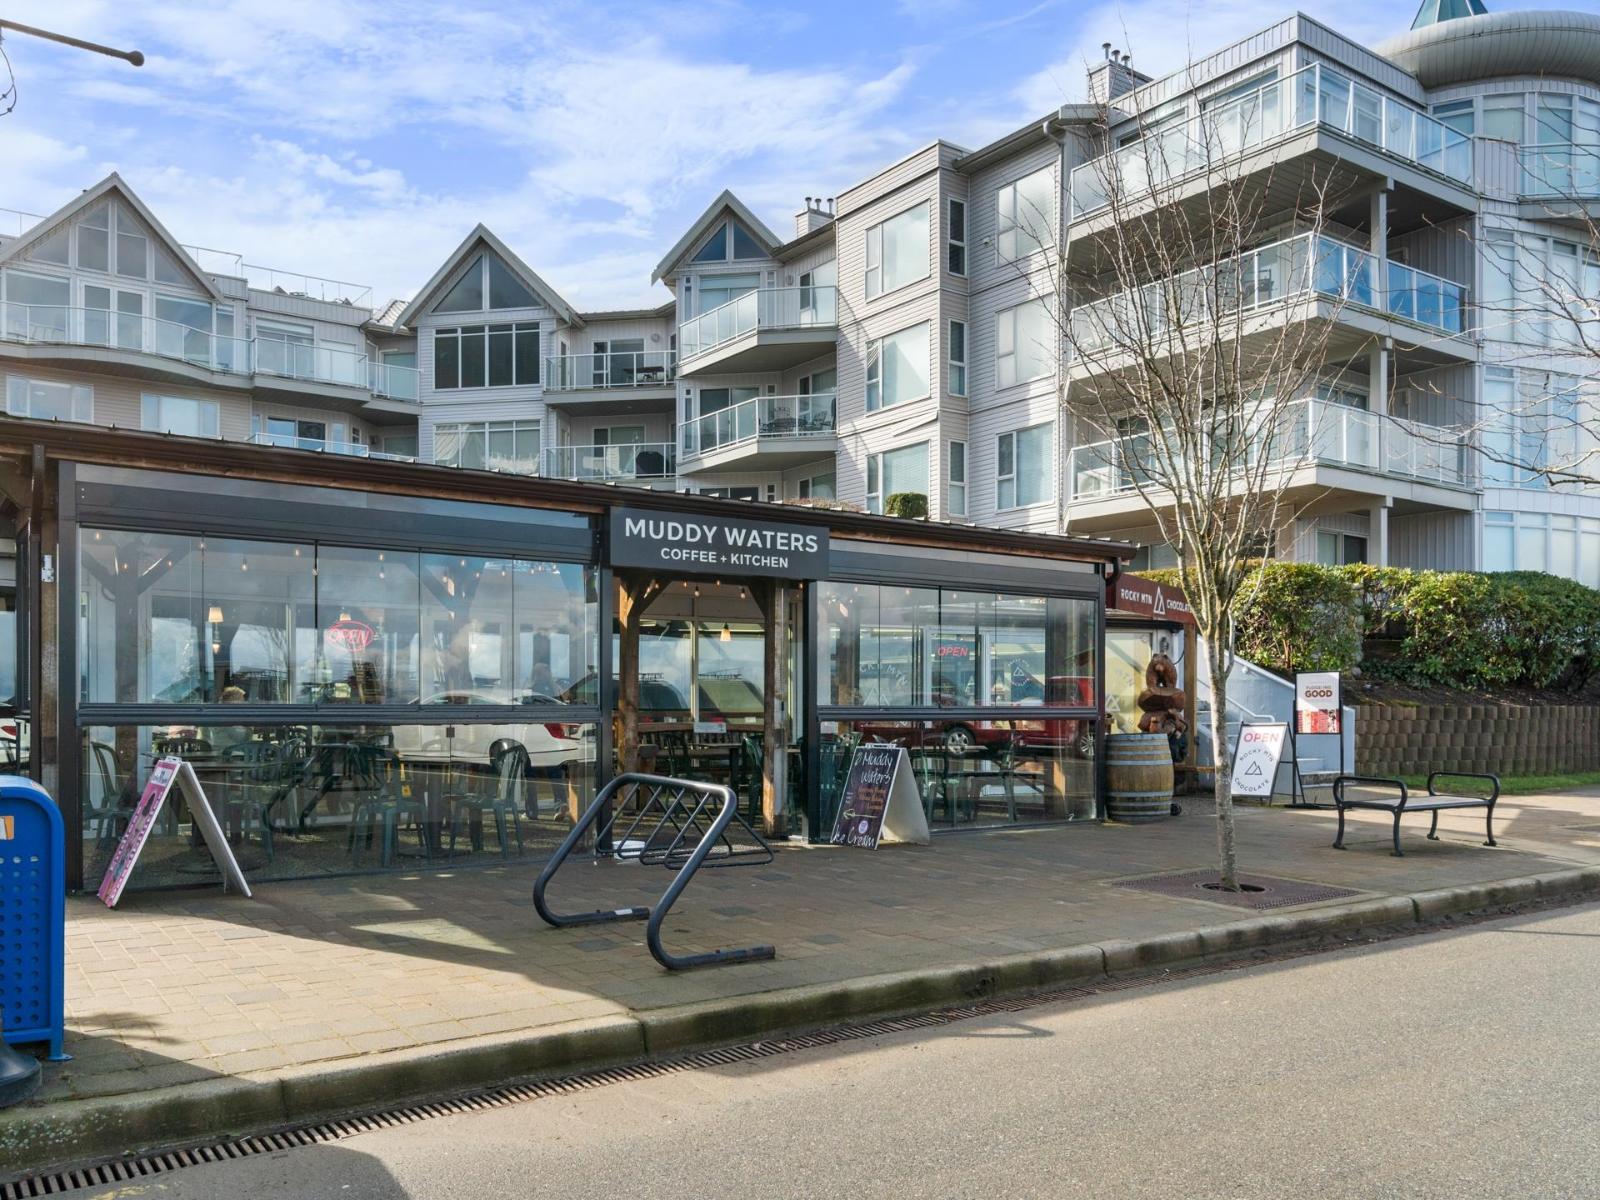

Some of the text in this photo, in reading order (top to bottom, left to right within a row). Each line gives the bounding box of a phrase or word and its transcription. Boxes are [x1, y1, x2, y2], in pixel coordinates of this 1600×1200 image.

[625, 517, 818, 553] MUDDY WATERS
[660, 548, 718, 563] COFFEE
[730, 553, 789, 568] KITCHEN
[1121, 589, 1191, 612] ROCKY MTN CHOCOLAT
[328, 624, 370, 646] OPEN
[938, 646, 968, 657] OPEN
[1305, 690, 1333, 698] GOOD
[1244, 732, 1279, 743] OPEN
[862, 752, 893, 774] Muddy
[1240, 749, 1273, 762] ROCKY MTN
[861, 768, 891, 784] Waters
[1235, 777, 1269, 792] CHOCOLATE
